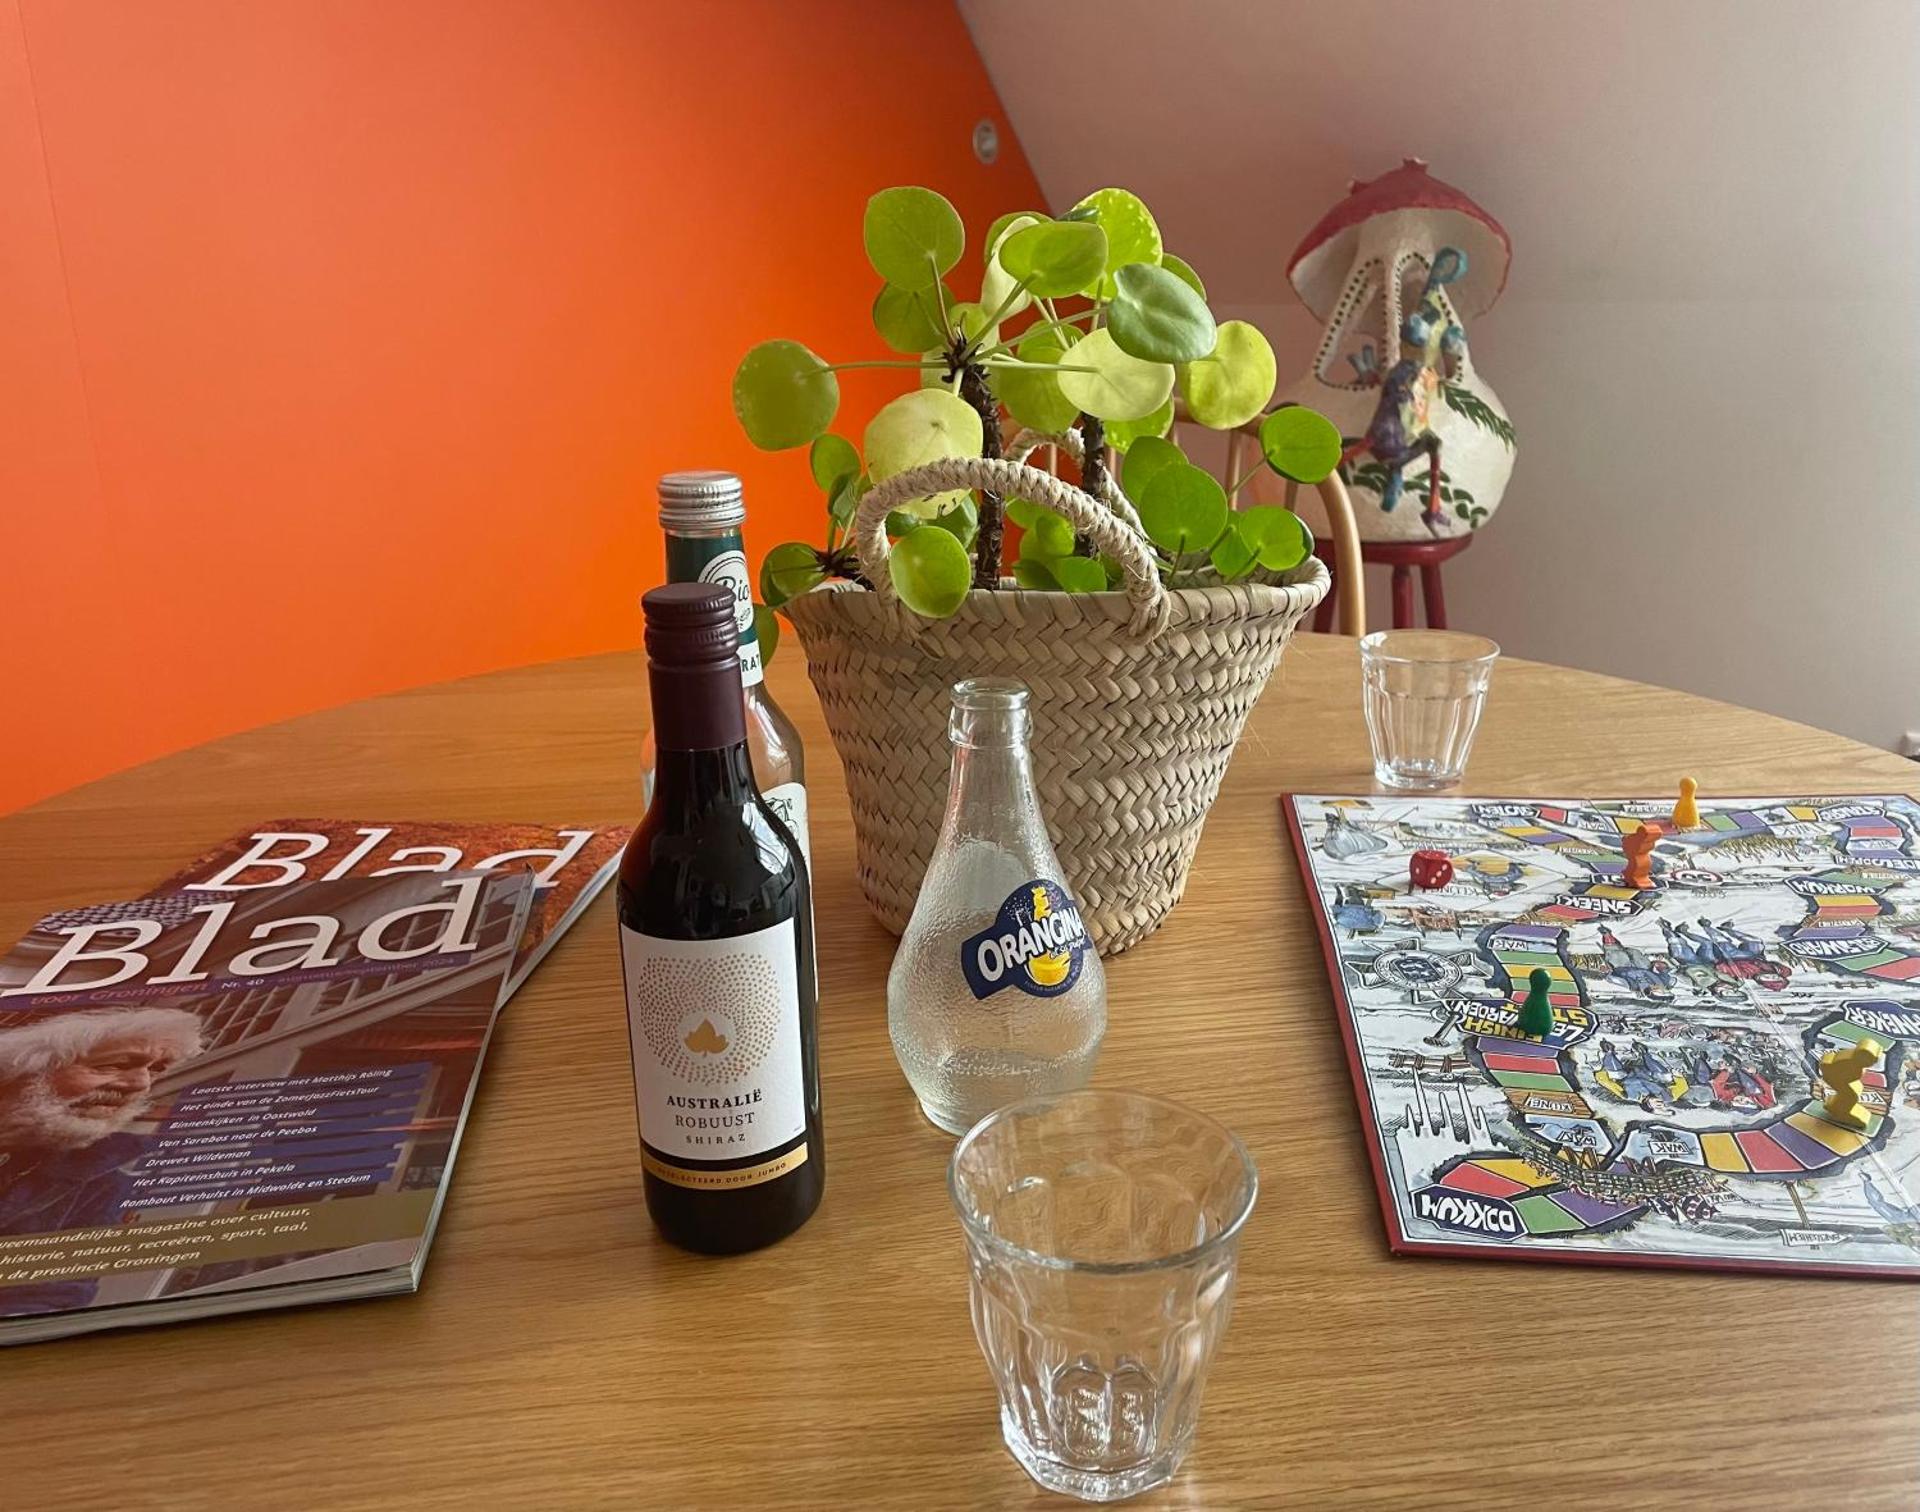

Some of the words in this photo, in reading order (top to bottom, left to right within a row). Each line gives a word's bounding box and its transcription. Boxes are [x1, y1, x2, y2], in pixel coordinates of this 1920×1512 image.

[183, 828, 594, 891] Blad
[1791, 881, 1875, 894] WORKUM
[1562, 895, 1632, 914] SNEEK
[0, 876, 484, 998] Blad
[977, 906, 1086, 982] ORANGINA
[30, 993, 82, 1005] voor
[89, 983, 209, 1001] Groningen
[246, 978, 265, 986] 40
[234, 1081, 287, 1091] interview
[288, 1078, 311, 1086] met
[312, 1074, 357, 1083] Matthijs
[180, 1104, 202, 1112] Het
[203, 1100, 235, 1110] einde
[666, 1089, 762, 1110] AUSTRALIË
[169, 1117, 244, 1129] Binnenkijken
[247, 1114, 260, 1122] in
[262, 1108, 317, 1121] Oostwold
[675, 1112, 755, 1129] ROBUUST
[158, 1140, 180, 1148] Van
[230, 1132, 260, 1141] naar
[260, 1129, 275, 1138] de
[277, 1126, 318, 1137] Peebos
[686, 1133, 746, 1144] SHIRAZ
[1565, 1133, 1594, 1146] WAK
[1656, 1143, 1685, 1153] WAK
[145, 1156, 191, 1167] Drewes
[192, 1151, 252, 1163] Wildeman
[133, 1178, 157, 1188] Het
[157, 1170, 239, 1185] Kapiteinshuis
[254, 1163, 296, 1175] Pekela
[726, 1174, 752, 1184] DOOR
[758, 1162, 786, 1177] JUMBO
[119, 1195, 177, 1208] Rombout
[180, 1190, 231, 1202] Verhulst
[232, 1188, 244, 1196] in
[246, 1181, 306, 1195] Midwolde
[307, 1180, 323, 1188] en
[324, 1174, 371, 1187] Stedum
[127, 1220, 207, 1235] magazine
[210, 1215, 246, 1226] over
[249, 1208, 311, 1221] cultuur,
[1421, 1194, 1516, 1232] DOKKUM
[0, 1250, 66, 1265] historie,
[72, 1244, 132, 1258] natuur,
[137, 1234, 215, 1250] recreëren,
[220, 1228, 267, 1242] sport,
[273, 1221, 309, 1233] taal,
[7, 1269, 29, 1280] de
[29, 1261, 110, 1280] provincie
[113, 1251, 201, 1268] Groningen
